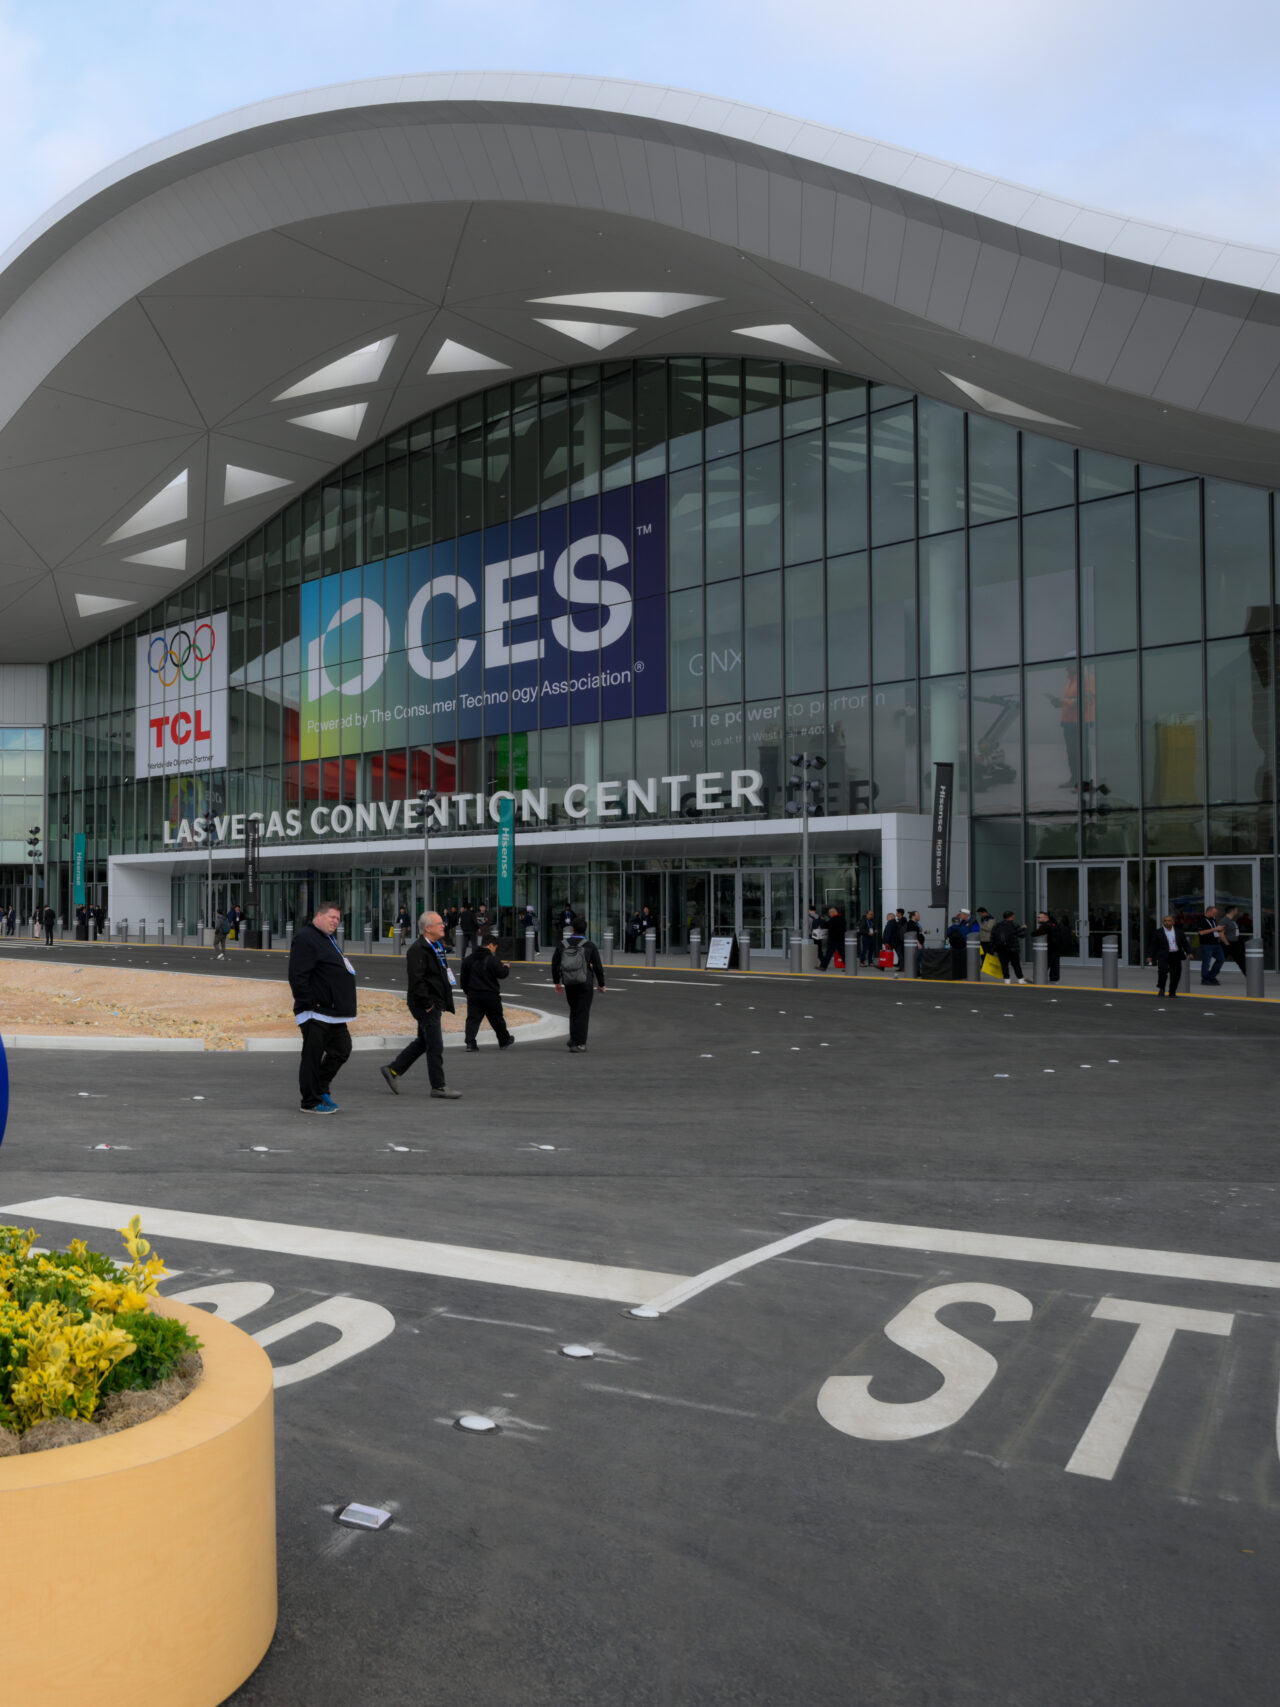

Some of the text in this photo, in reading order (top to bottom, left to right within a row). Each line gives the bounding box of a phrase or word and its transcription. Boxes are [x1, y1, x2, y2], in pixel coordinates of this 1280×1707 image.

[150, 709, 211, 748] TCL
[307, 713, 352, 733] Powered
[355, 713, 368, 728] by
[370, 708, 391, 723] The
[394, 699, 457, 719] Consumer
[459, 685, 538, 708] Technoogy
[164, 817, 207, 843] LAS
[564, 769, 764, 818] CENTER
[501, 827, 510, 878] Hisense
[817, 1282, 1280, 1480] ST
